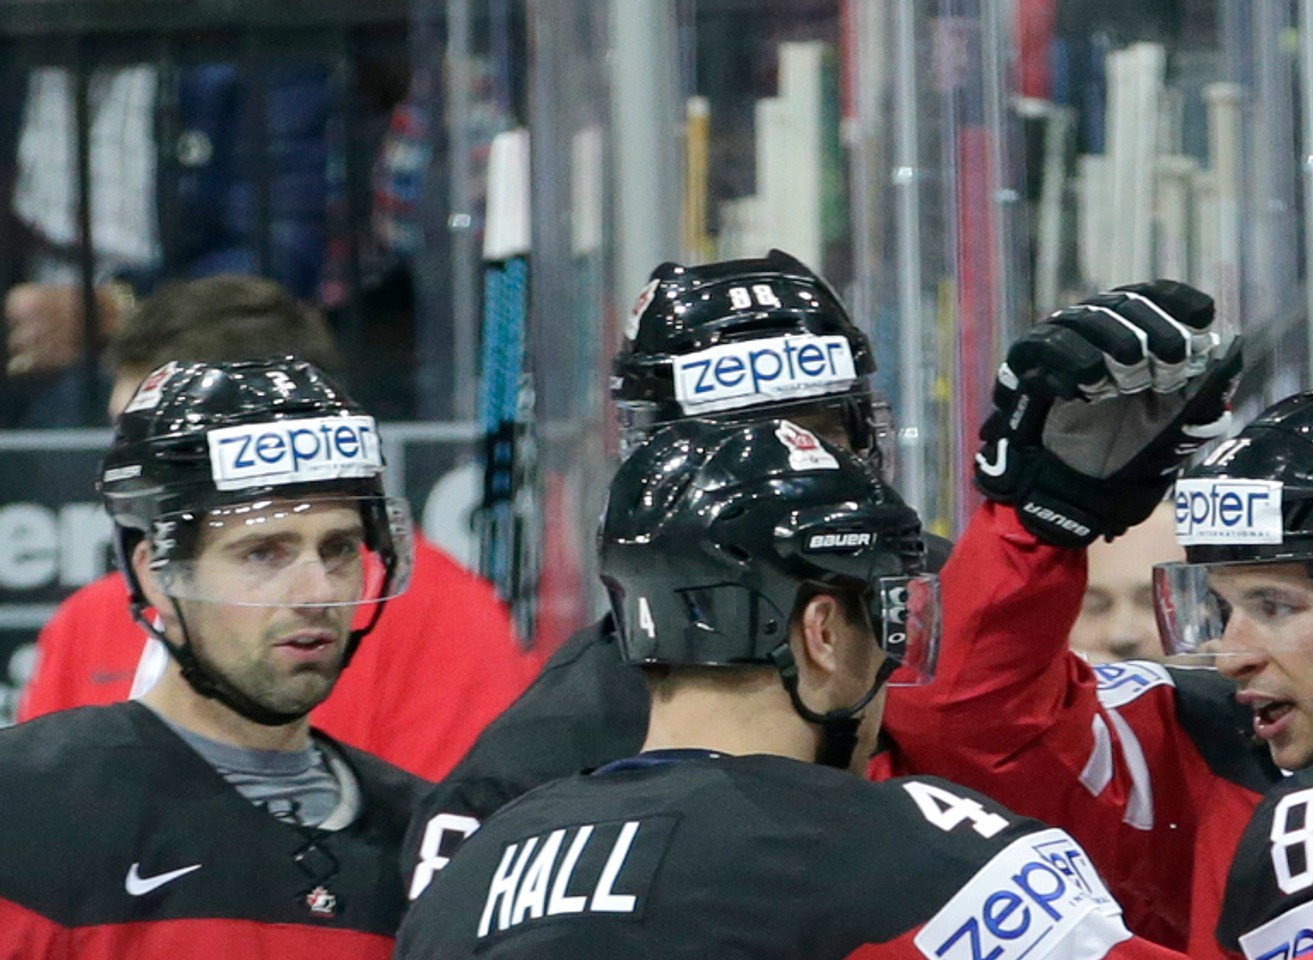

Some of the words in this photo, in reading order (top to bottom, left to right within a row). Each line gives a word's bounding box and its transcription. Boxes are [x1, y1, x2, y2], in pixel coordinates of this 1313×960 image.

[682, 339, 842, 394] zepter
[218, 423, 370, 472] zepter
[809, 533, 871, 549] BAUER
[638, 597, 655, 638] 4
[902, 781, 1010, 839] 4
[476, 820, 641, 938] HALL
